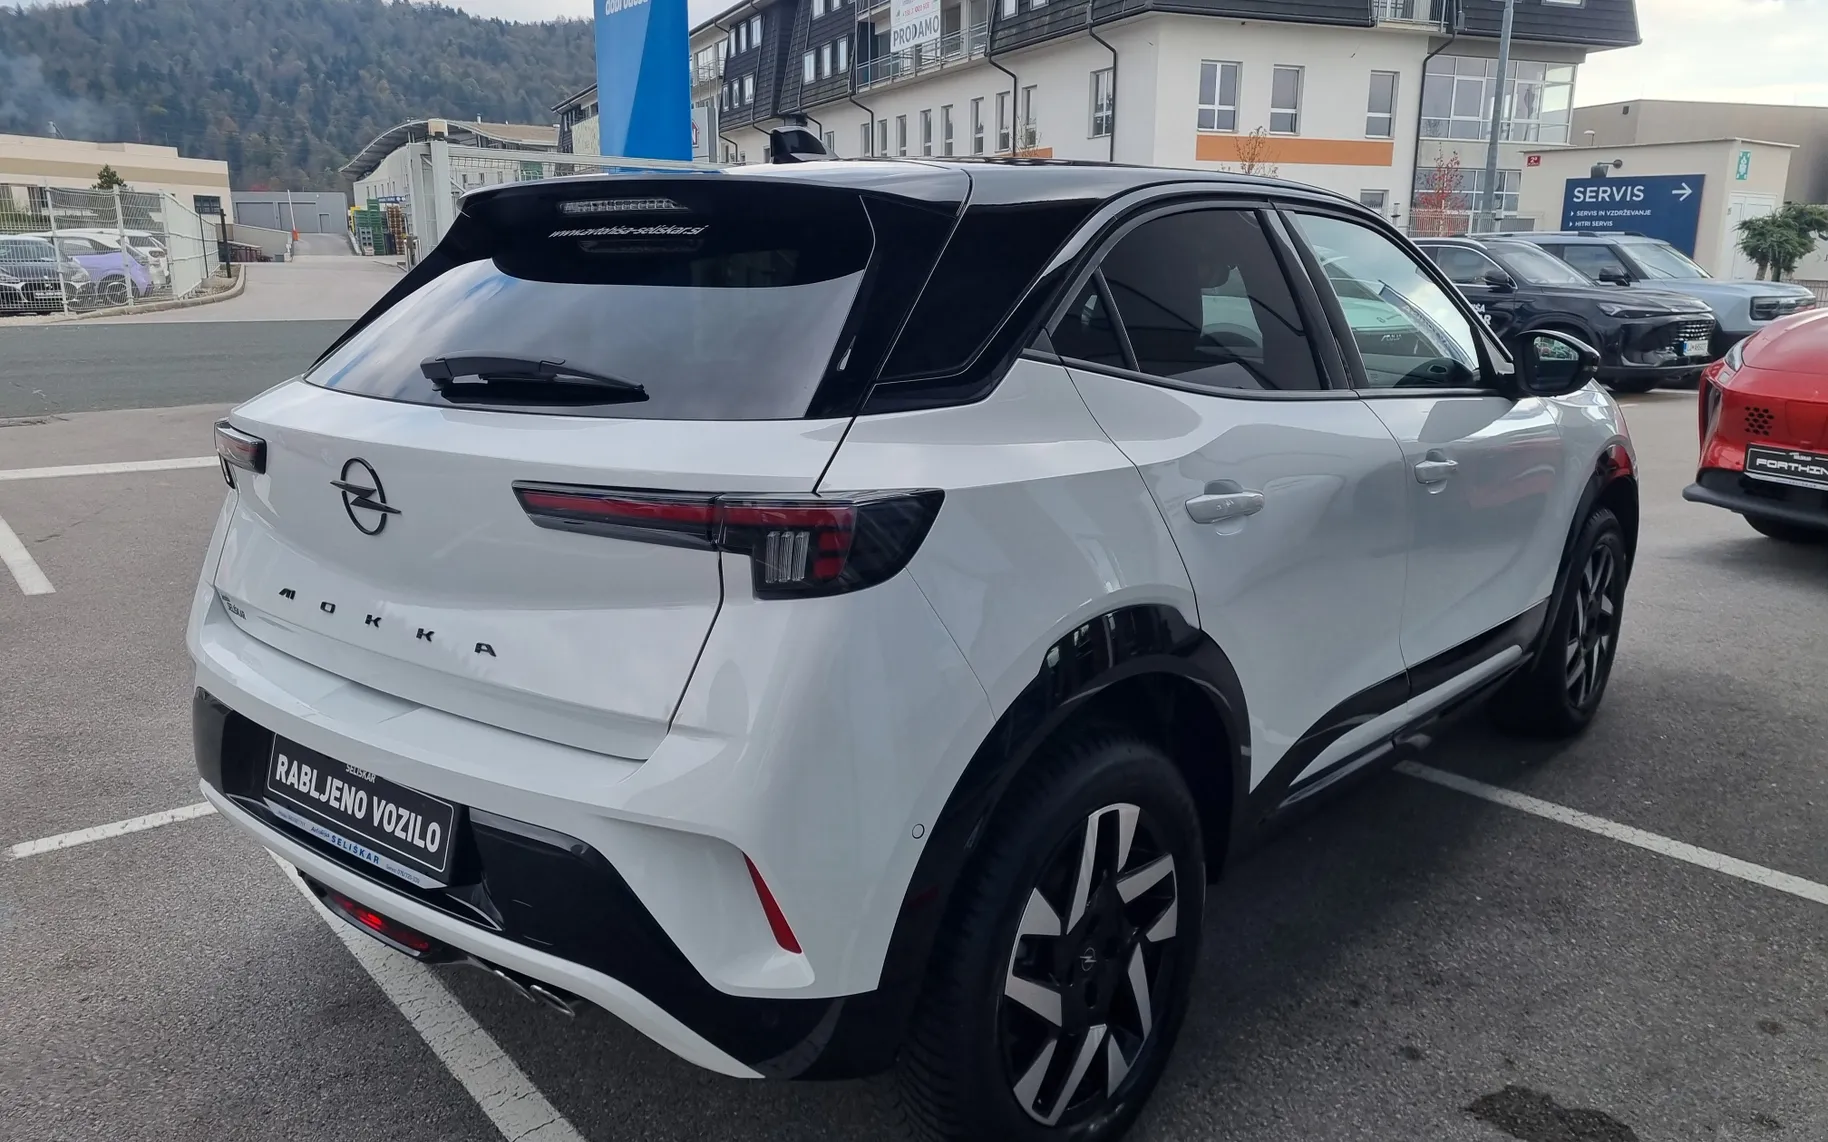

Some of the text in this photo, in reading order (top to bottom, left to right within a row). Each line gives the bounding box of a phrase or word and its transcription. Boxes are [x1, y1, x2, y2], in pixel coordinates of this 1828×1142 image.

[893, 15, 940, 47] PRODAMO
[1573, 185, 1645, 202] SERVIS
[279, 587, 497, 657] MOKKA
[276, 754, 441, 853] RABLJENO VOZILO
[331, 835, 380, 865] SELIŠKAR
